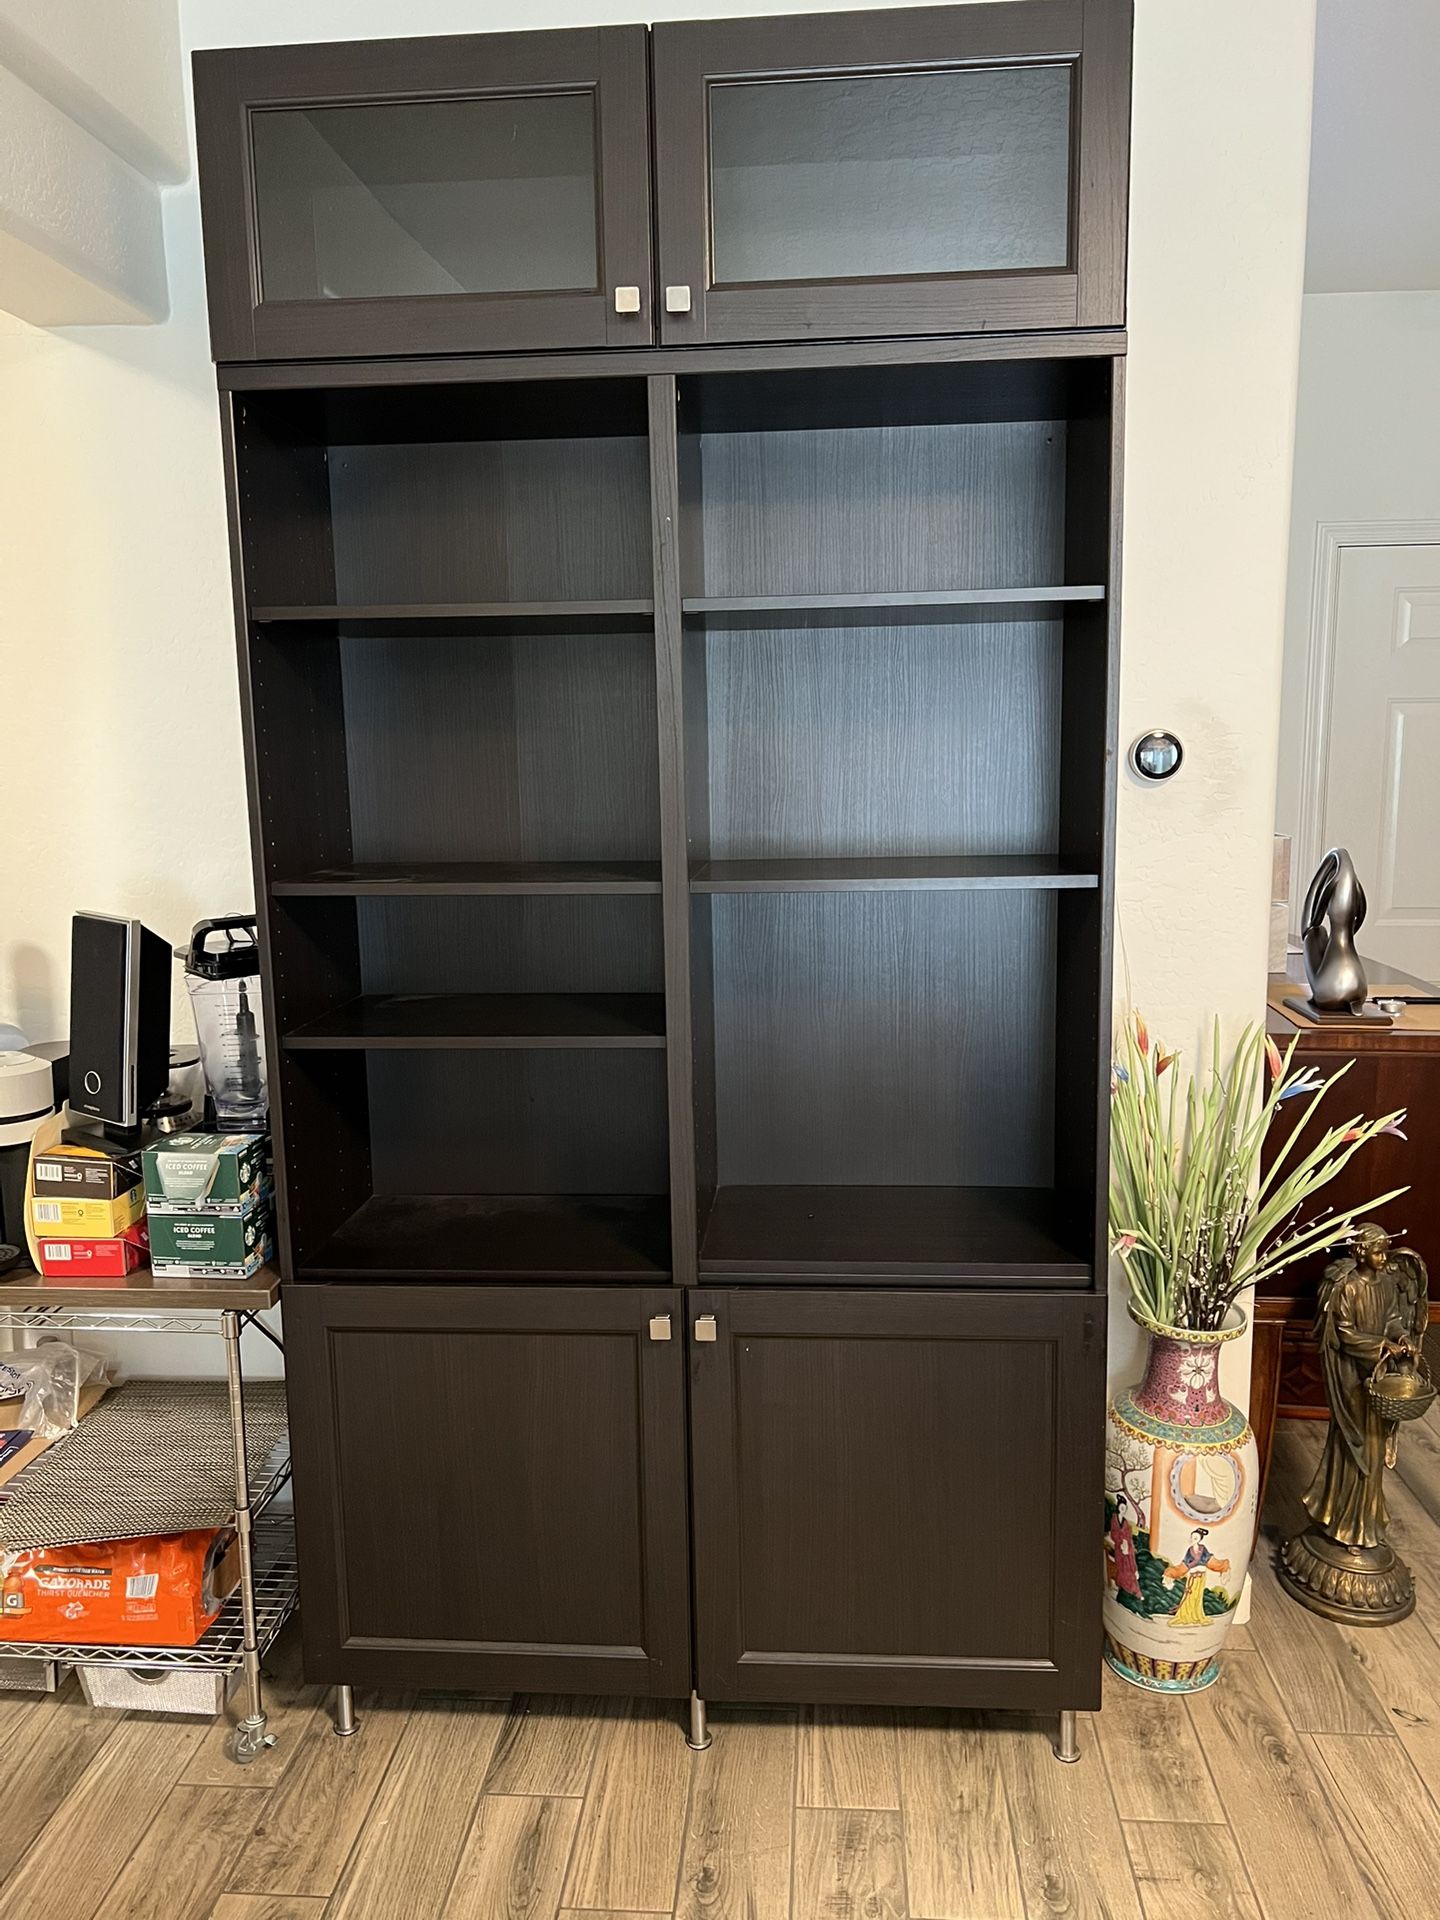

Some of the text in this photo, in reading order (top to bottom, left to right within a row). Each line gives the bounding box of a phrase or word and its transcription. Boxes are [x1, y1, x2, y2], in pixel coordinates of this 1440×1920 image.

[40, 1577, 111, 1591] GATORADE
[37, 1588, 110, 1599] THIRST QUENCHER
[6, 1594, 18, 1607] G
